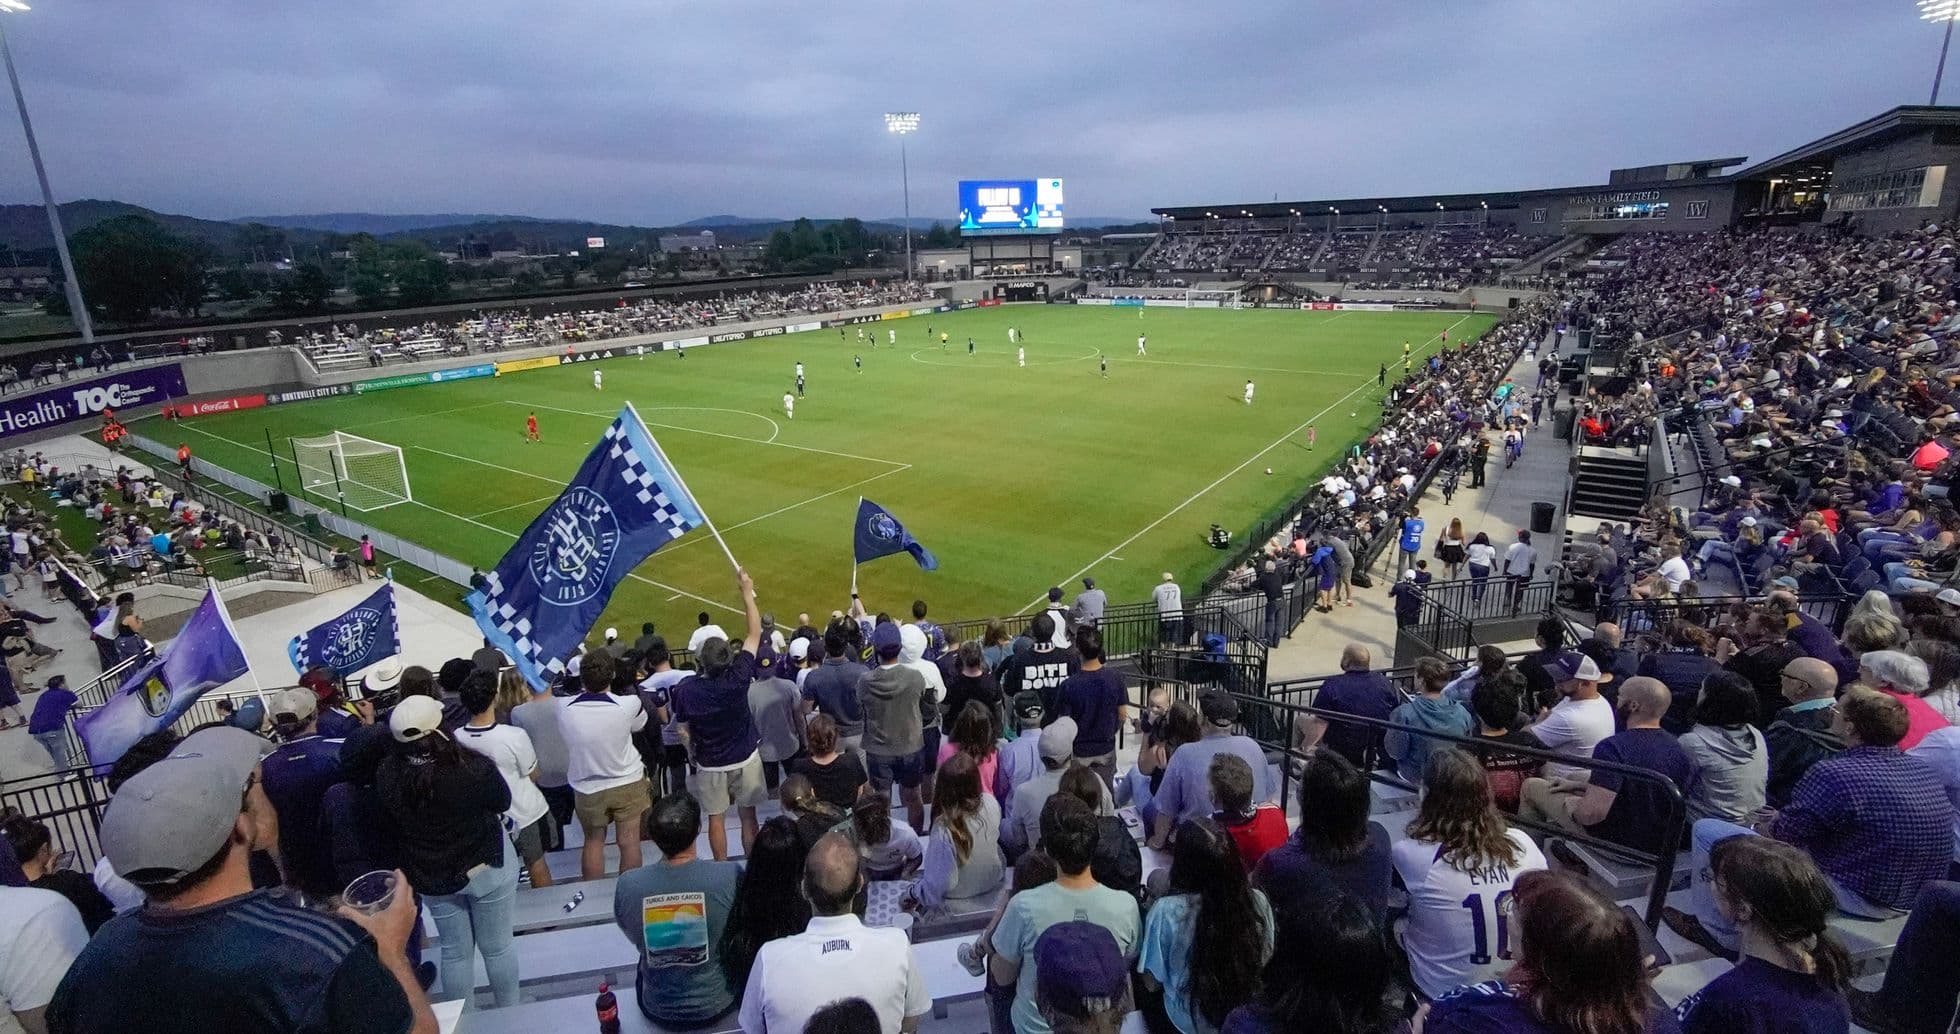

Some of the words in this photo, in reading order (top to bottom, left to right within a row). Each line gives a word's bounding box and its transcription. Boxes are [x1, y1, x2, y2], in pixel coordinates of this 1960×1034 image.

[1598, 192, 1631, 203] FAMILY
[1633, 191, 1660, 201] FIELD
[73, 383, 121, 415] TOC
[0, 400, 66, 433] Health
[646, 897, 664, 905] TURKS
